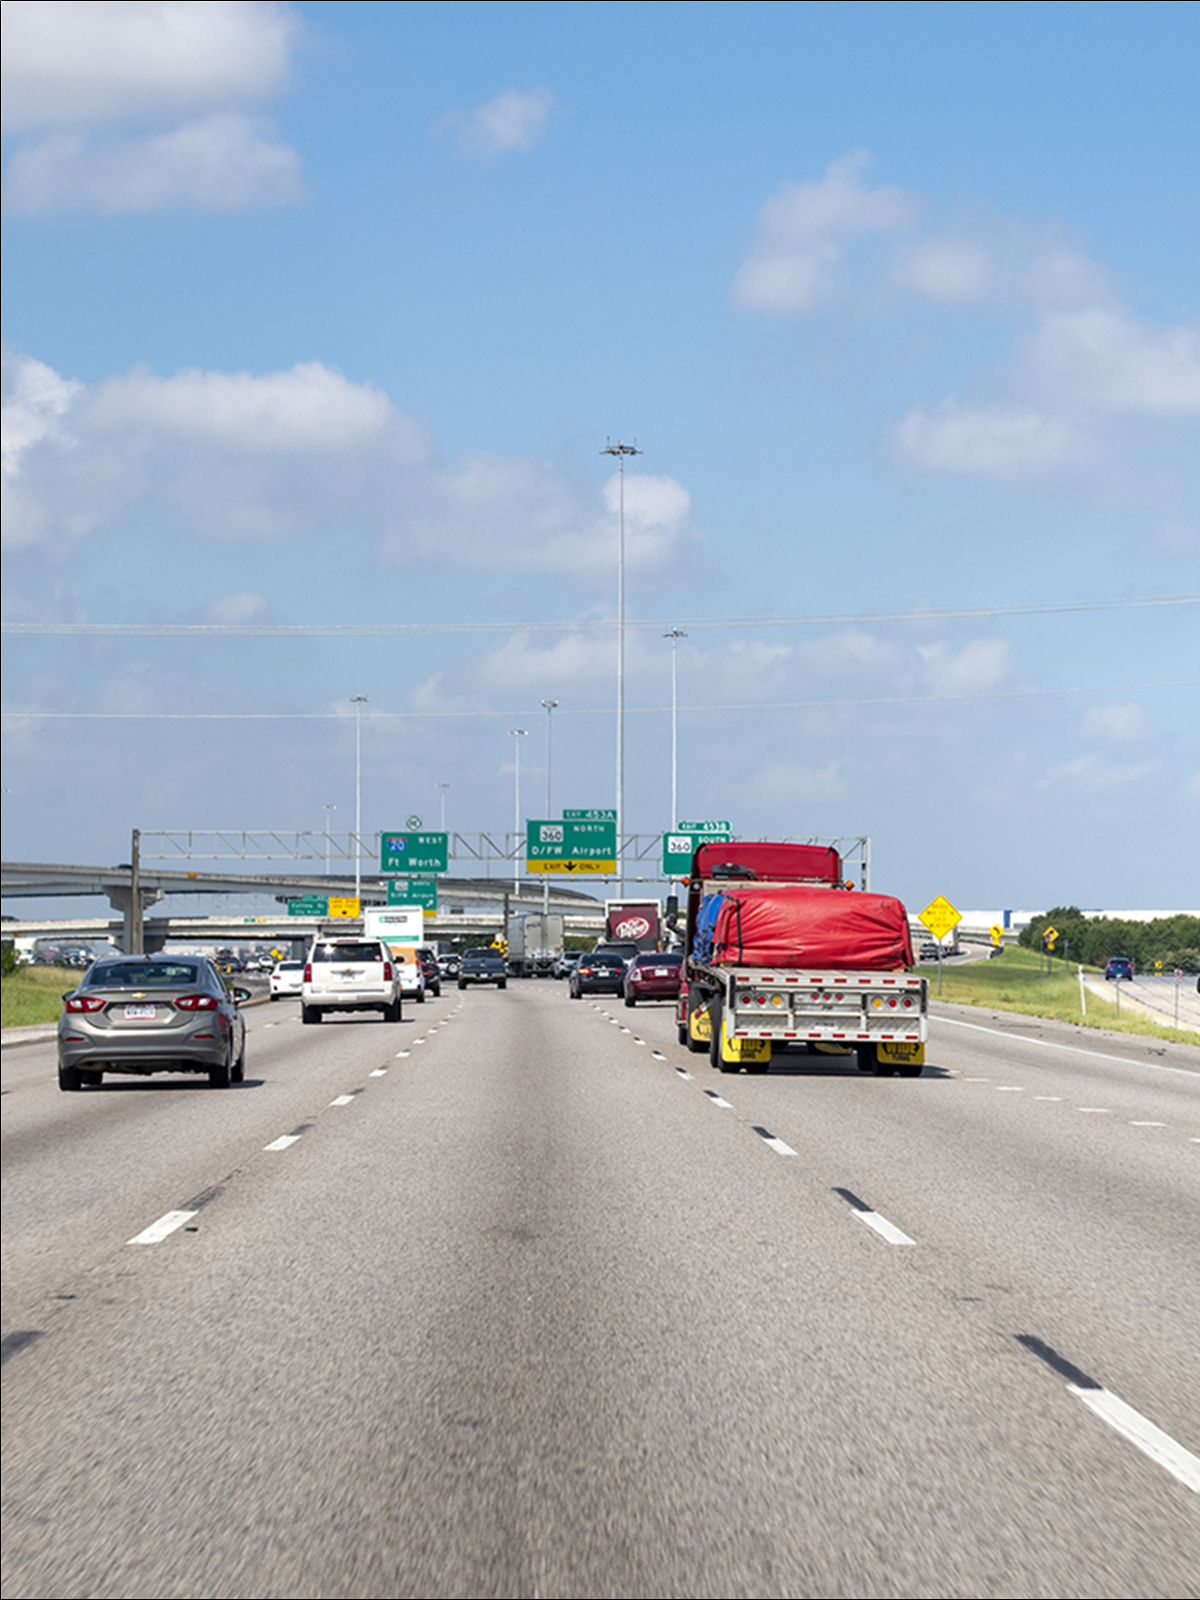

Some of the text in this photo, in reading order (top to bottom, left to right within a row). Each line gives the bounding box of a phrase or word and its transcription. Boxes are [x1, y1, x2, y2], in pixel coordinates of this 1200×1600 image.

[573, 825, 605, 833] NORTH
[418, 836, 443, 844] WEST
[541, 831, 562, 841] 360
[531, 846, 612, 857] D/FW Airport
[670, 842, 691, 852] 360
[388, 857, 441, 868] Ft Worth
[543, 862, 602, 871] EXIT ONLY
